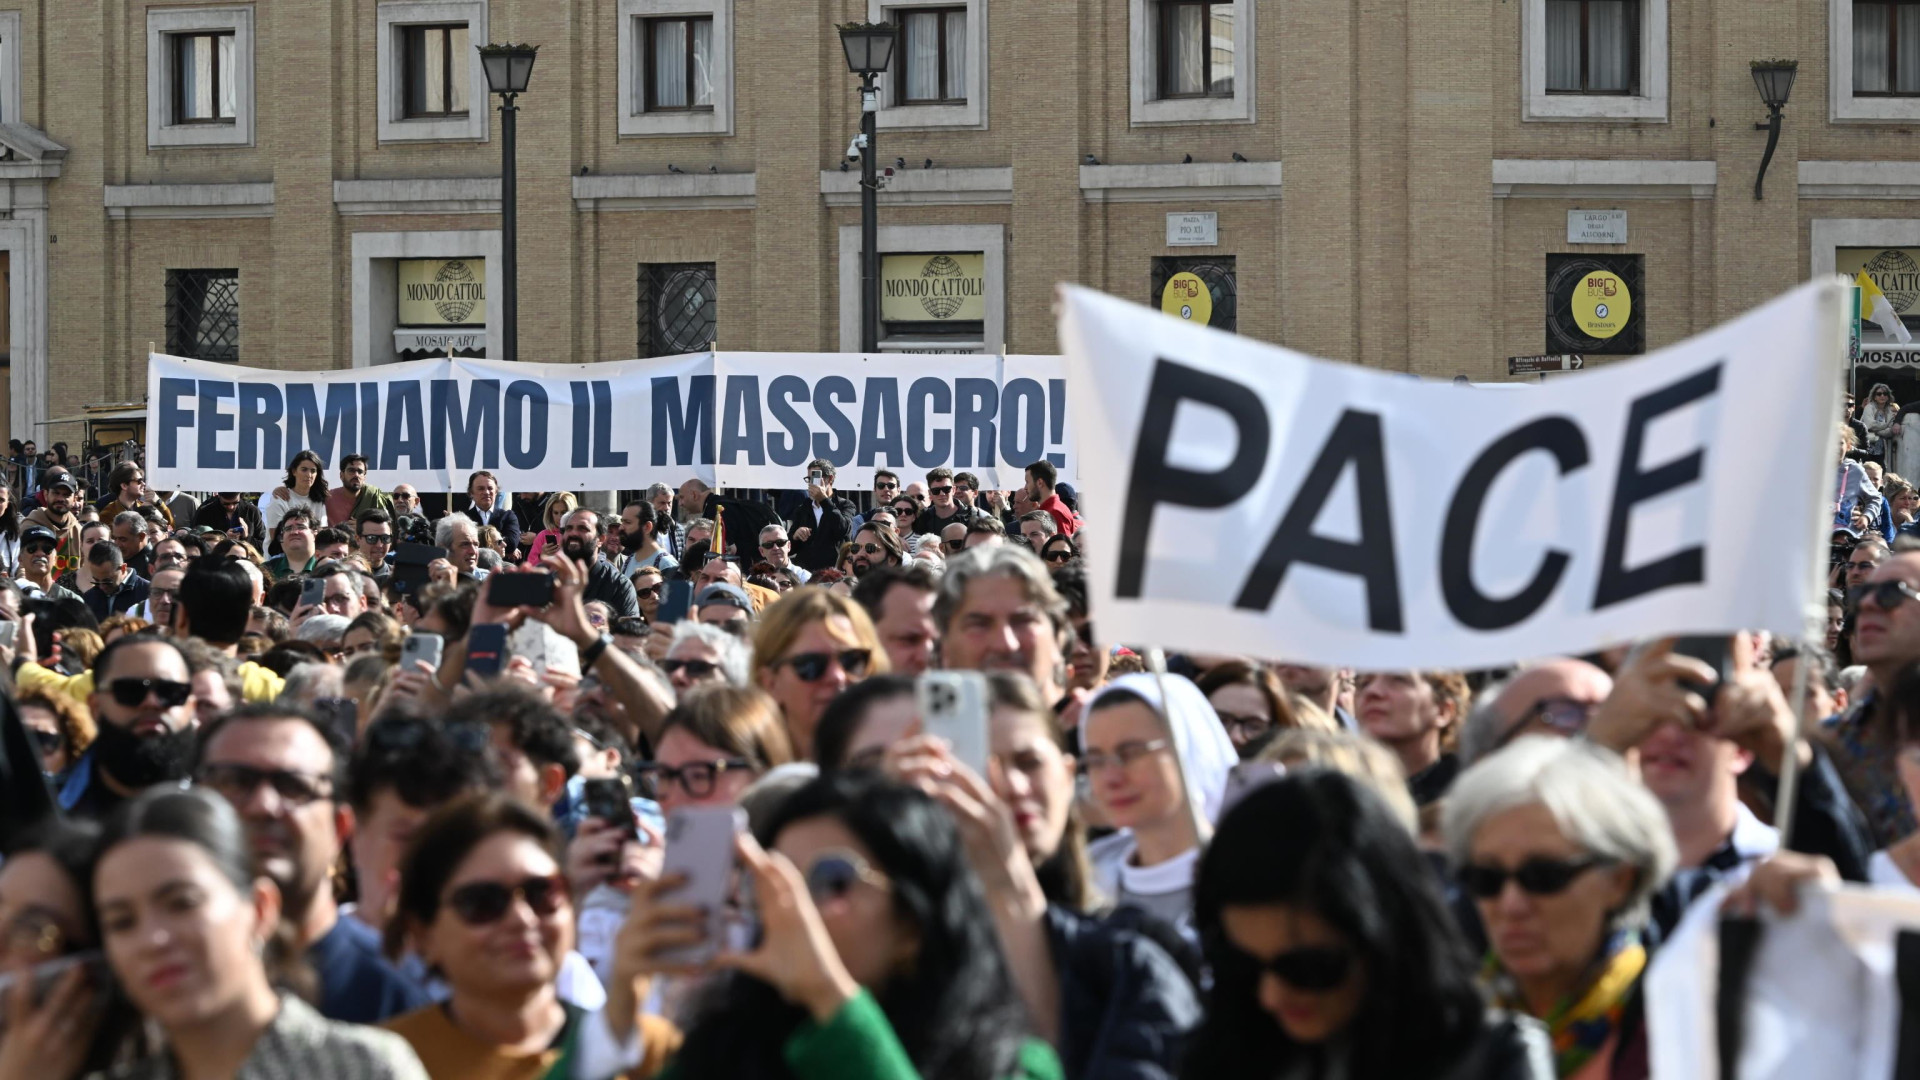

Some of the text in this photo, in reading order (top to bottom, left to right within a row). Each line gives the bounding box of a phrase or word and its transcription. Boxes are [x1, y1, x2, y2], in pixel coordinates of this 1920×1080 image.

[886, 278, 984, 296] MONDO CATTOLI
[1174, 280, 1187, 288] BIG
[1588, 278, 1604, 288] BIG
[407, 283, 485, 300] MONDO CATTOL
[1588, 288, 1604, 296] BUS
[456, 336, 477, 346] ART
[158, 375, 1067, 470] FERMIAMO IL MASSACRO!
[1114, 356, 1725, 634] PACE
